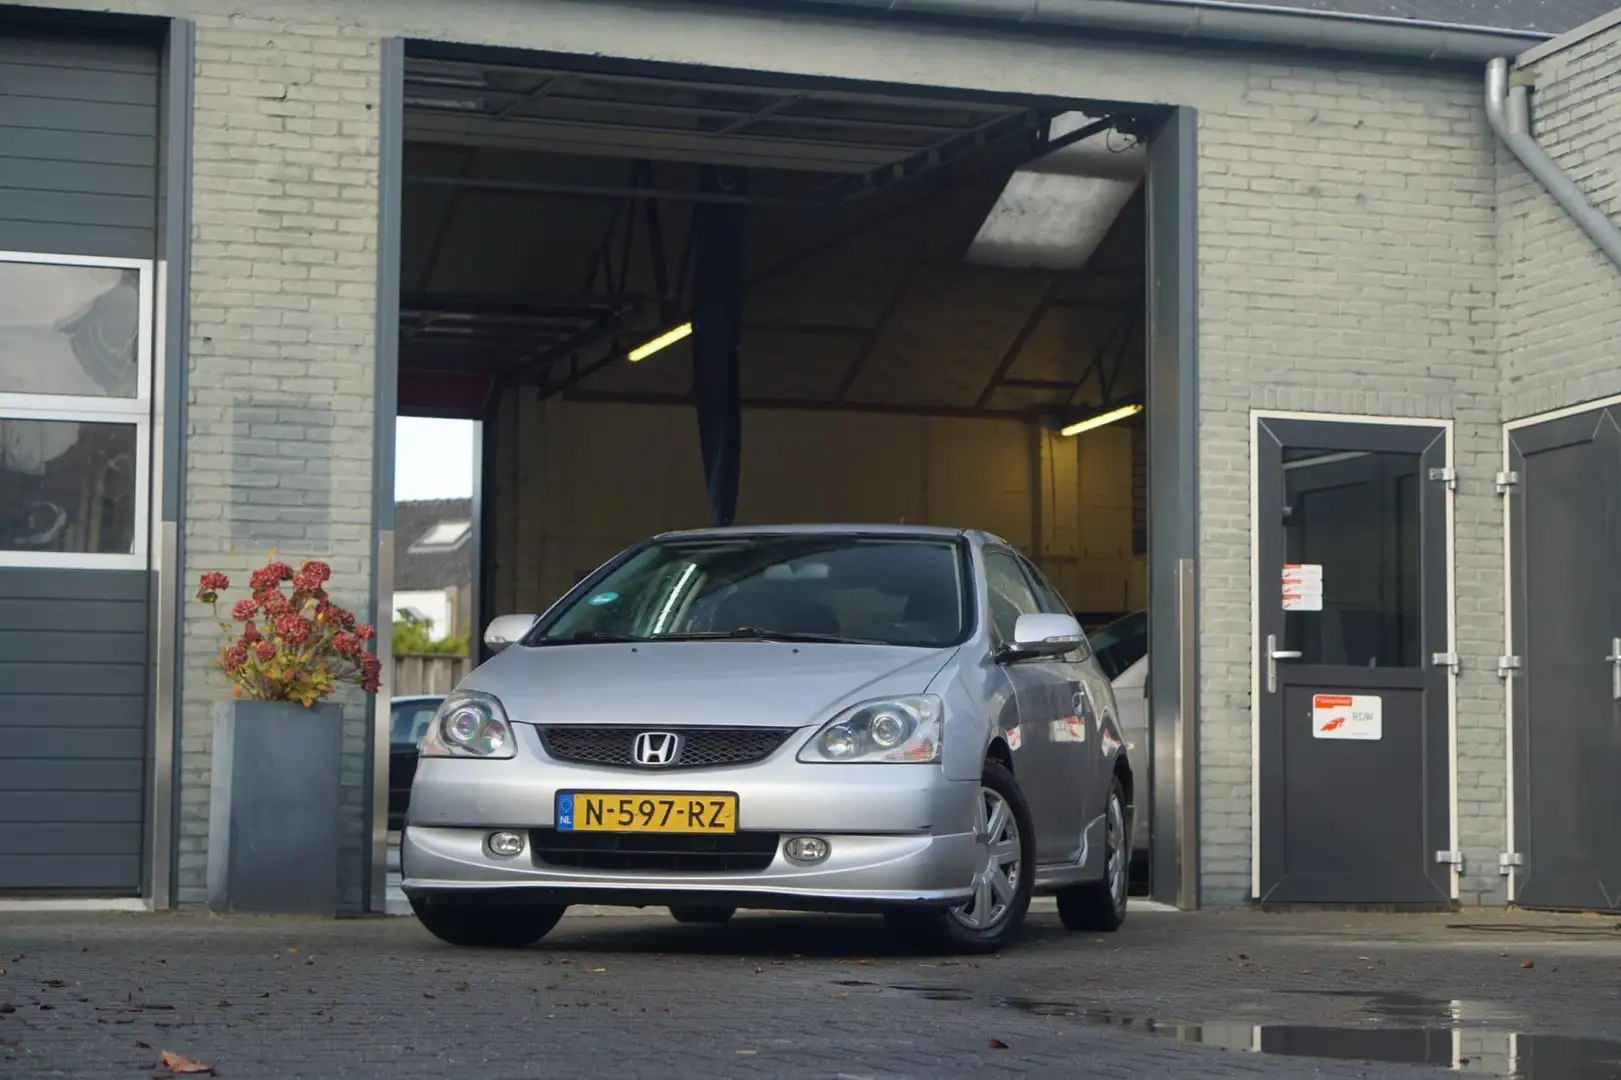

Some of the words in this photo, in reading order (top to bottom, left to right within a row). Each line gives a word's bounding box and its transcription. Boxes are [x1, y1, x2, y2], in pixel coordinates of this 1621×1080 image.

[1352, 711, 1374, 721] RDW
[585, 799, 726, 828] N-597-RZ
[559, 815, 572, 824] NL
